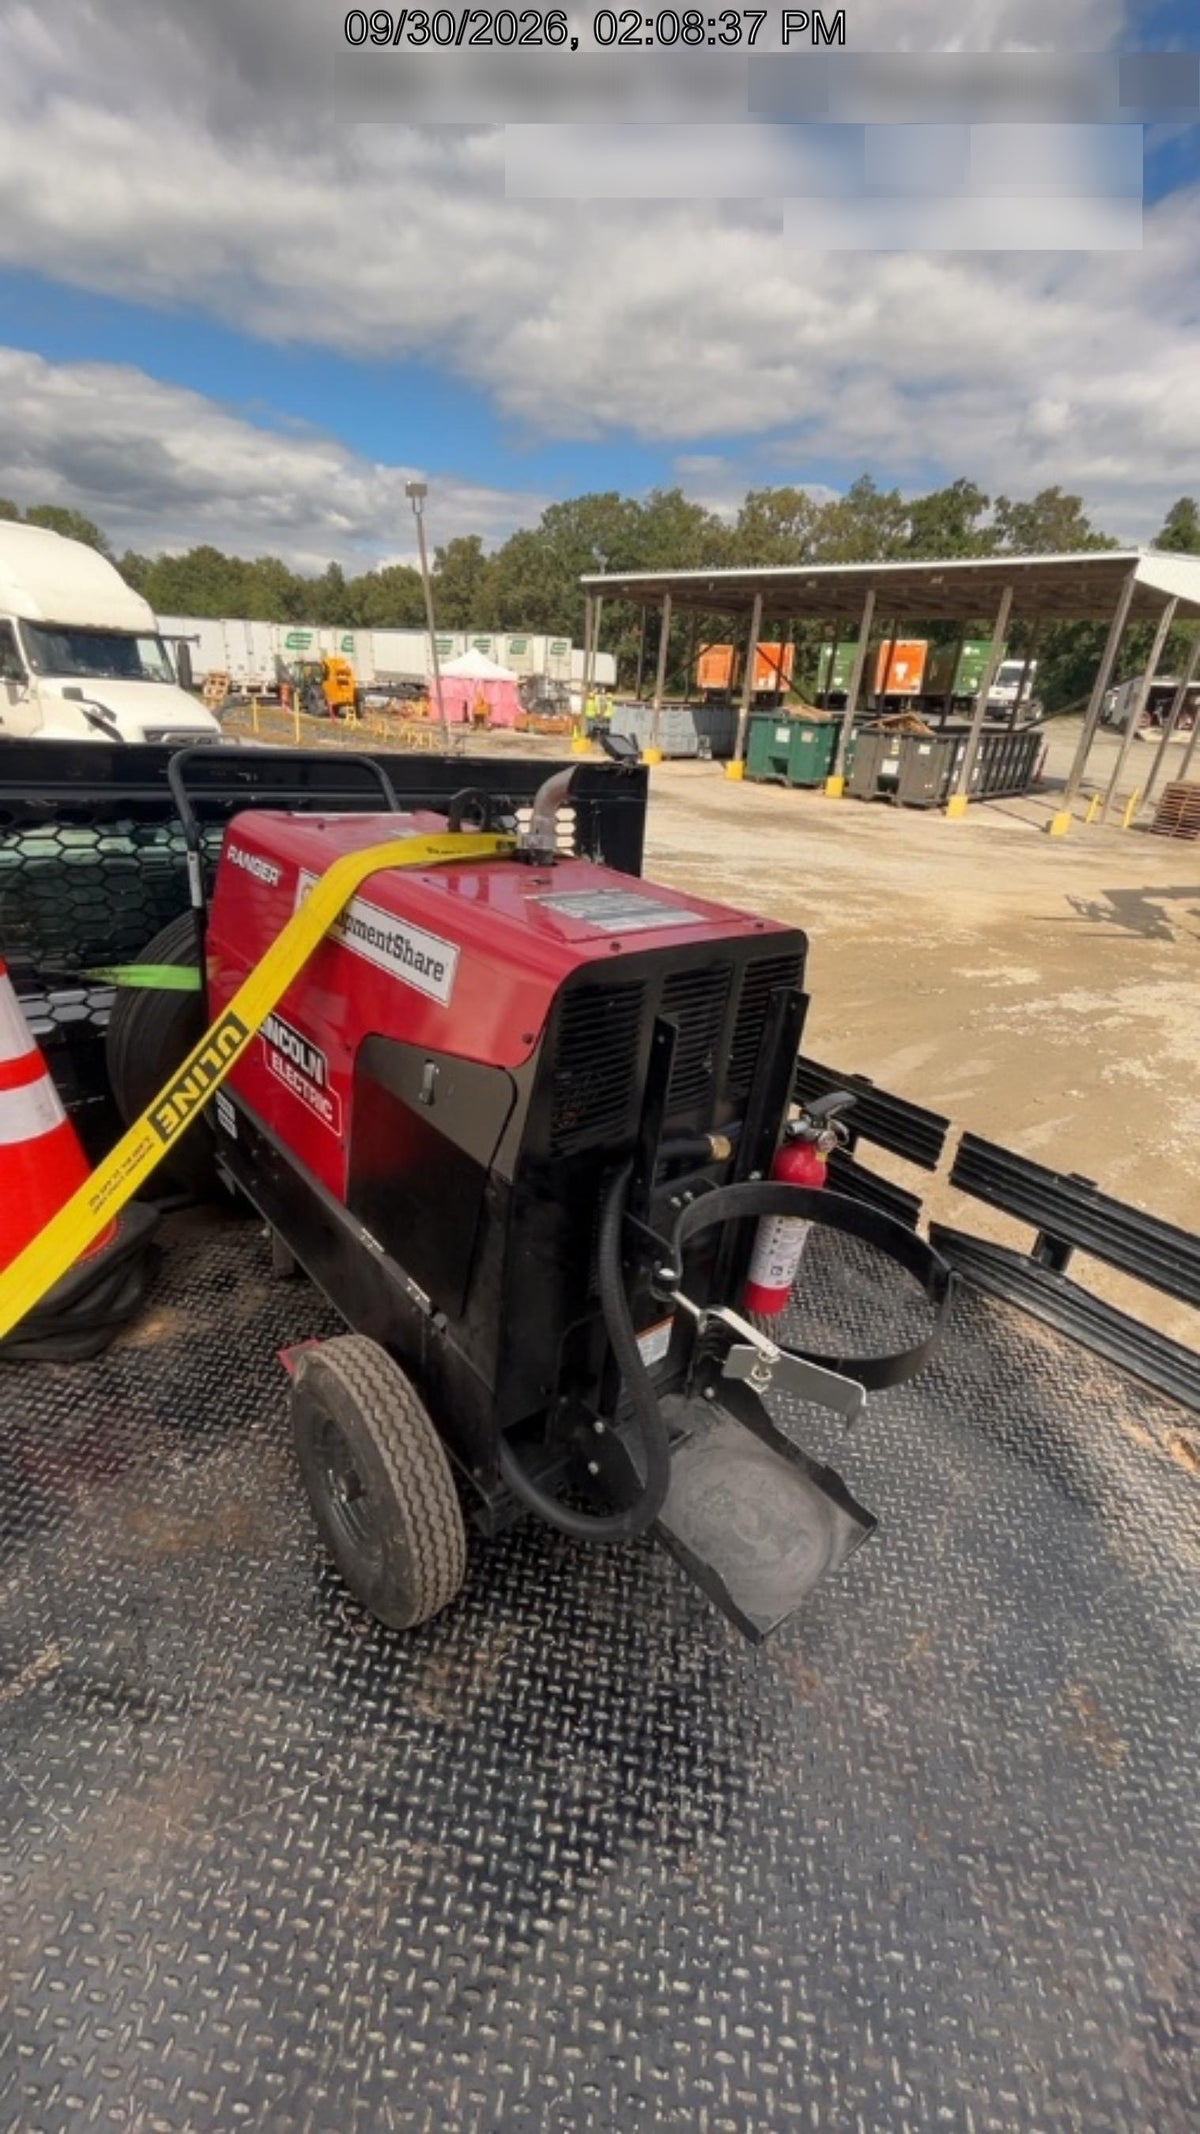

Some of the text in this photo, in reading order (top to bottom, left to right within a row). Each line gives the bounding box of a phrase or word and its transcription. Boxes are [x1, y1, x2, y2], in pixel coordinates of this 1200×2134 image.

[227, 845, 279, 887] RANGER
[156, 1025, 242, 1135] ULINE
[272, 1051, 333, 1122] ELECTRIC
